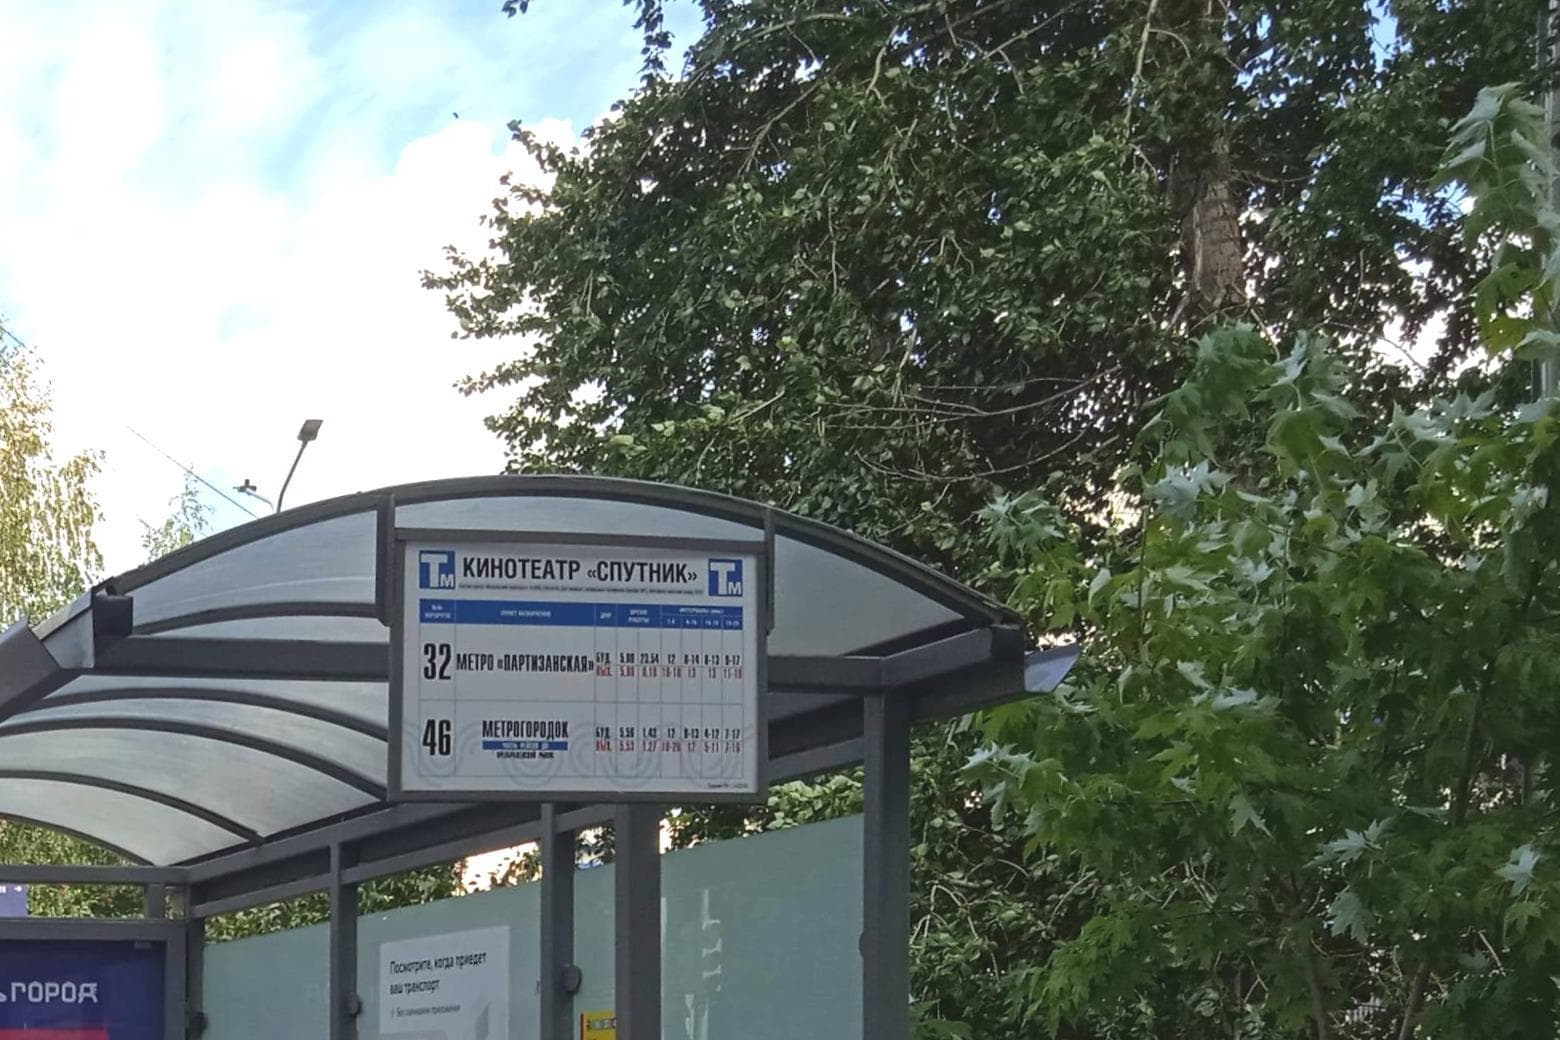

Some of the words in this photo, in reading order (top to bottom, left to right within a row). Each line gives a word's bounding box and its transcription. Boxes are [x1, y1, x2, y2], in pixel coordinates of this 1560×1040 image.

[463, 556, 581, 581] КИНОТЕАТР
[587, 560, 698, 584] «СПУТНИК»
[423, 643, 452, 681] 32
[456, 653, 494, 672] МЕТРО
[497, 653, 594, 673] «ПАРТИЗАНСКАЯ»
[422, 718, 452, 756] 46
[482, 720, 569, 740] МЕТРОГОРОДОК
[11, 981, 99, 1004] ГОРОД
